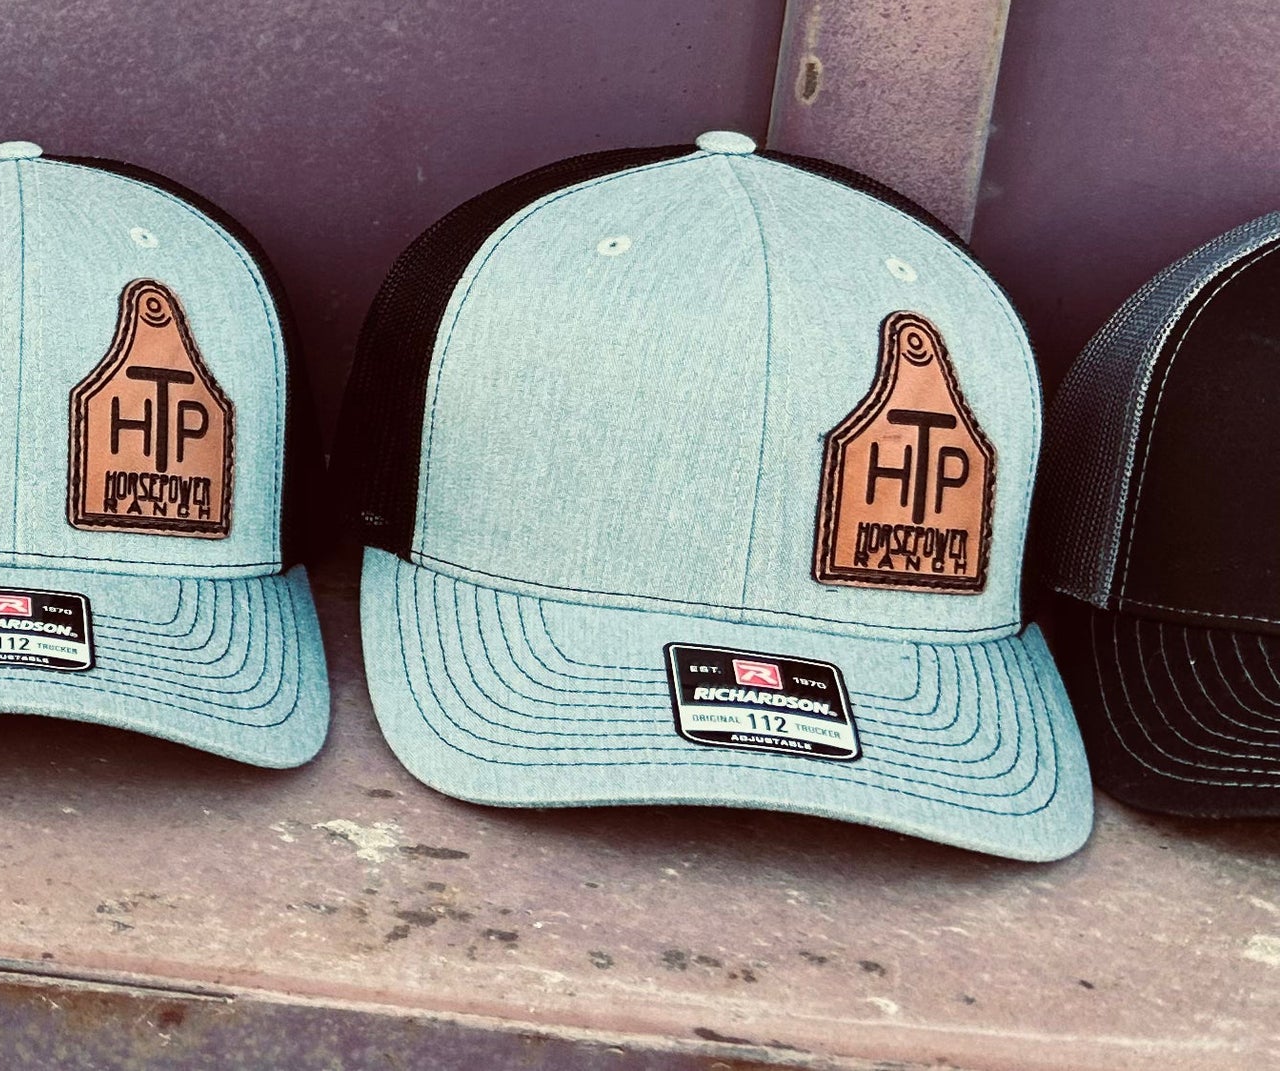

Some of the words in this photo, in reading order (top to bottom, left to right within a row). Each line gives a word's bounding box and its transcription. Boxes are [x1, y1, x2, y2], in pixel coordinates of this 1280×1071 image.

[42, 605, 73, 615] 1970
[37, 642, 78, 655] TRUCKER
[792, 677, 827, 689] 1970
[746, 713, 789, 733] 112
[795, 723, 841, 739] TRUCKER
